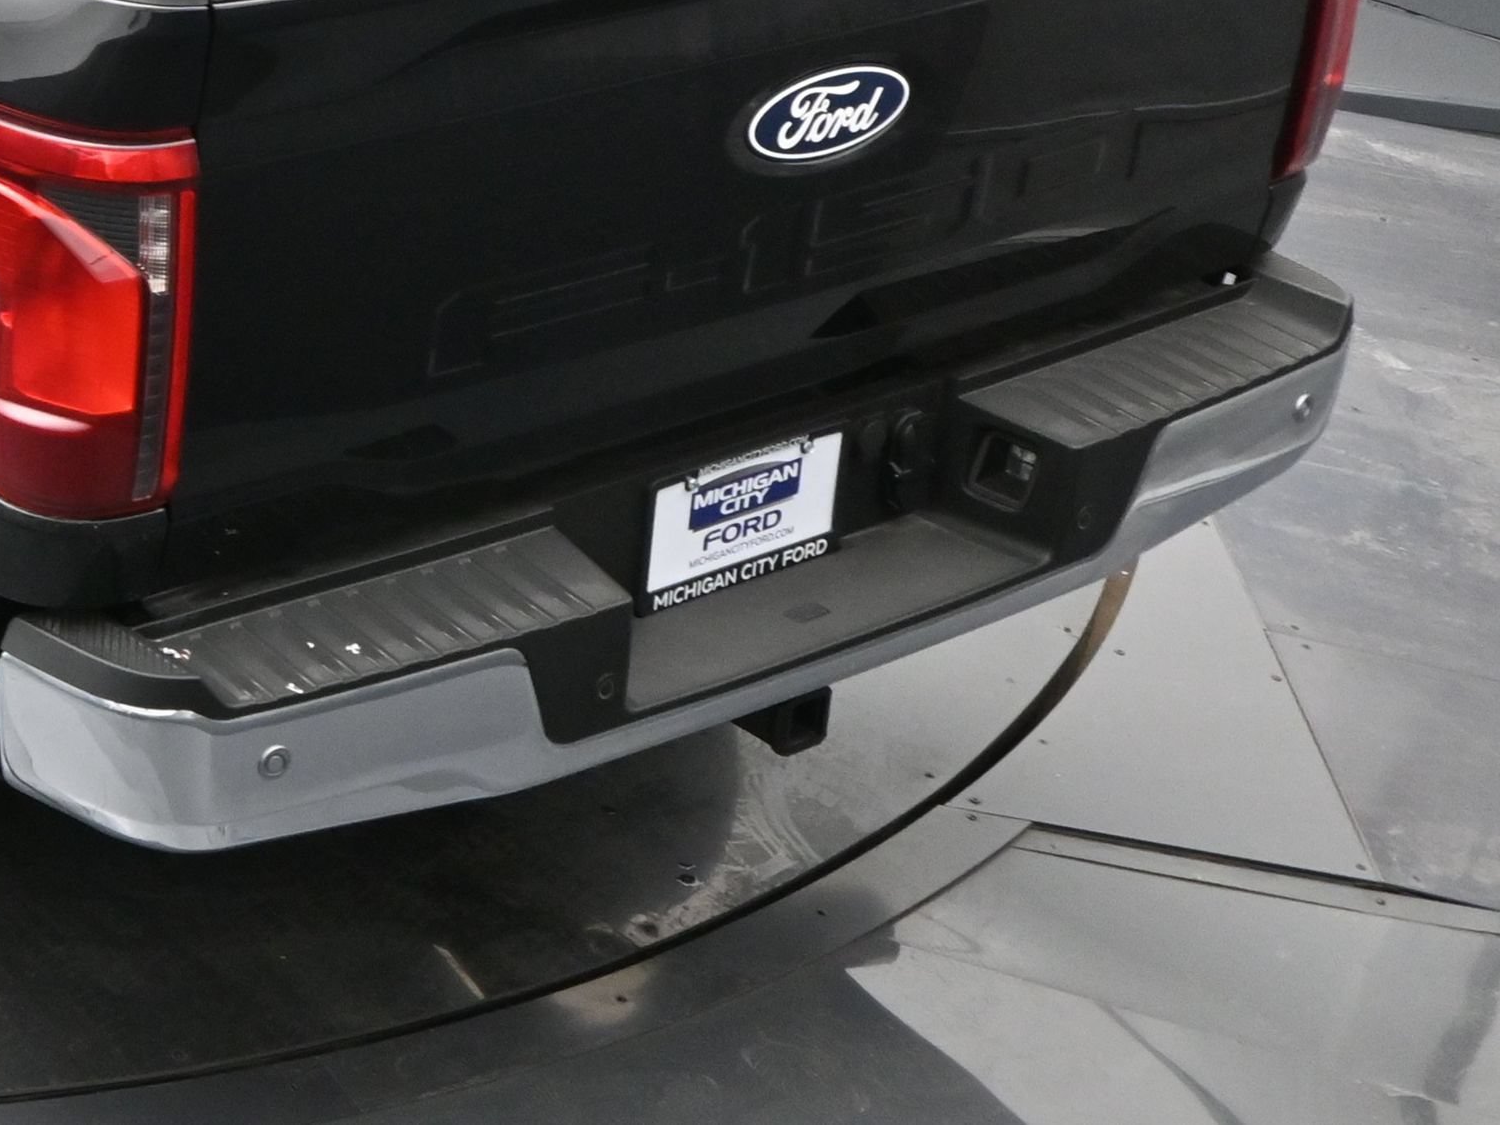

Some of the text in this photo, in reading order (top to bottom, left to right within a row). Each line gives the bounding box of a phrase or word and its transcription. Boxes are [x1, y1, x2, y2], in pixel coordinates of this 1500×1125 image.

[776, 80, 885, 150] Ford
[693, 461, 799, 511] MICHIGAN
[720, 488, 770, 515] CITY
[688, 525, 795, 569] MICHIGANCITYFORD.COM
[703, 508, 782, 552] FORD
[652, 537, 829, 611] MICHIGAN CITY FORD
